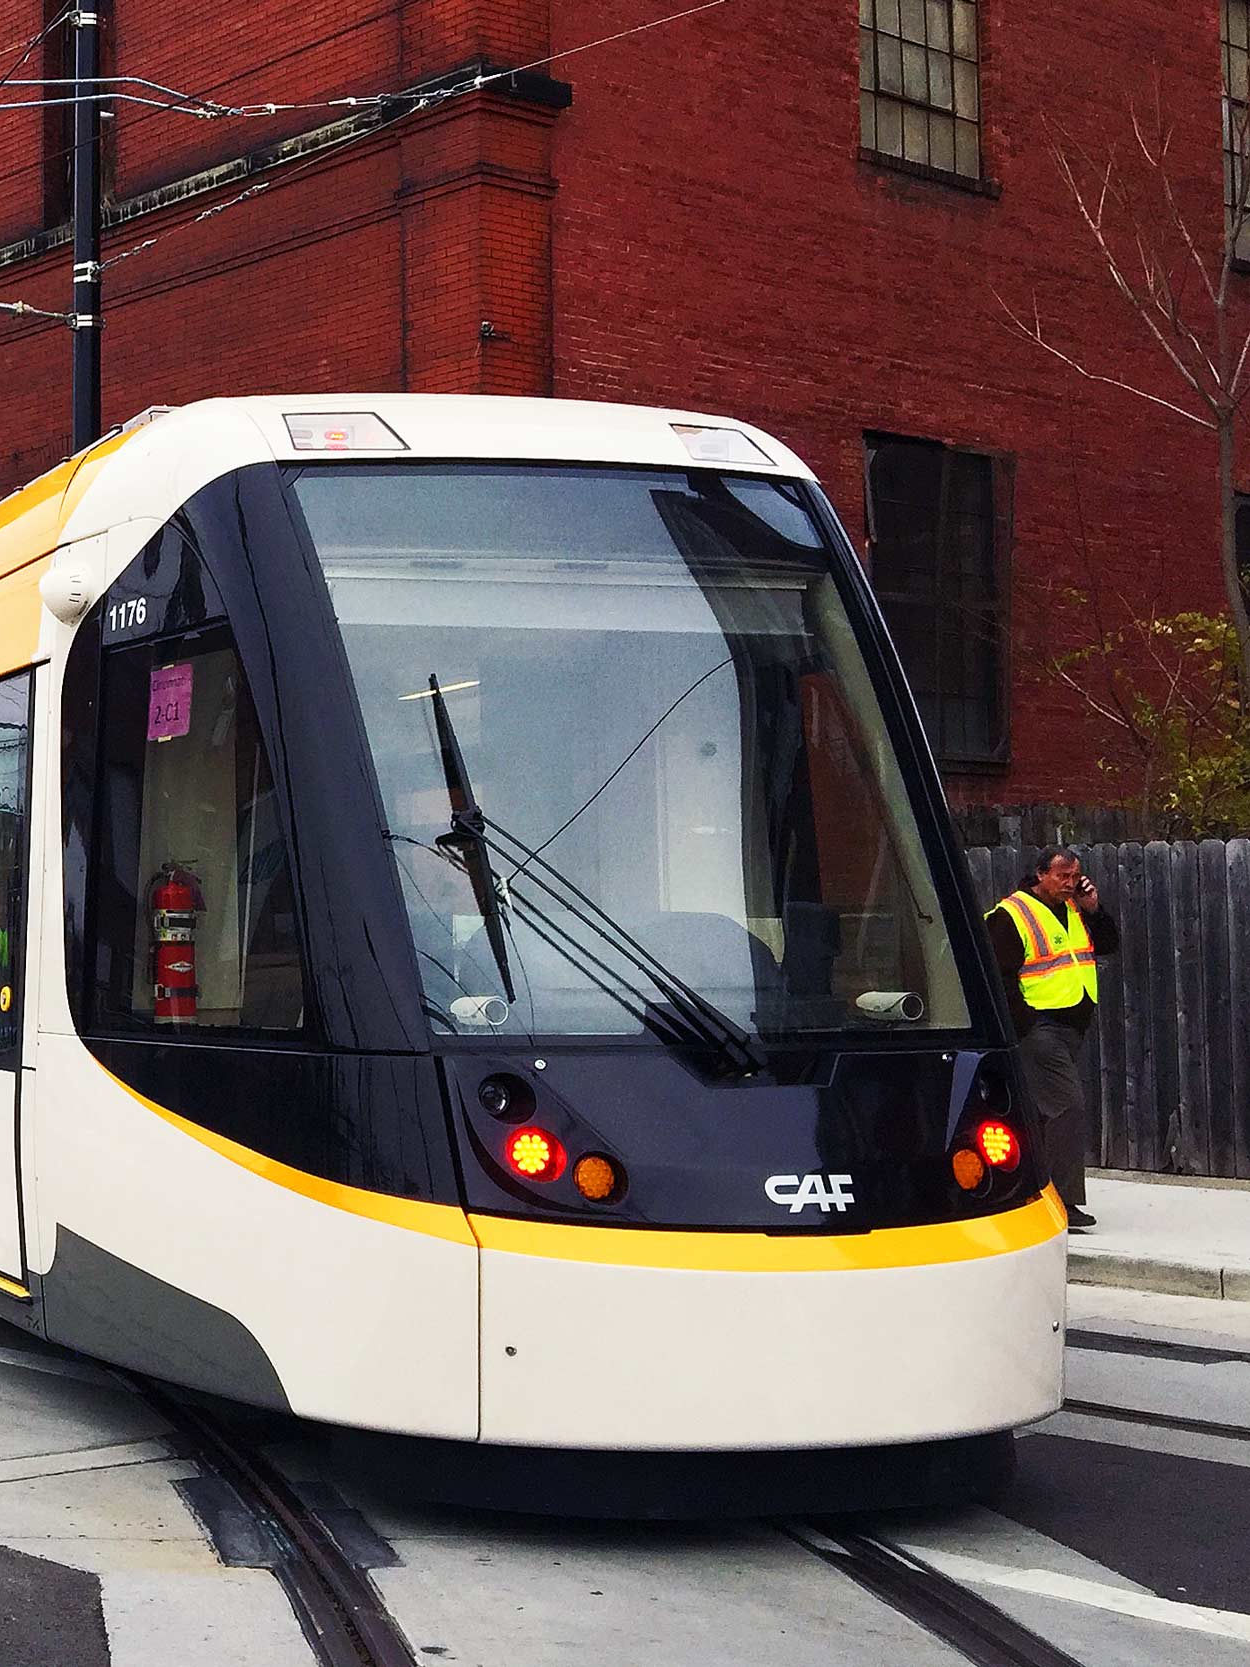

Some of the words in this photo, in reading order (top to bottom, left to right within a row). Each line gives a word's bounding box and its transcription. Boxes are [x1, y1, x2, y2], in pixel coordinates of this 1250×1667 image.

[109, 597, 147, 631] 1176
[154, 702, 179, 724] 2-C1
[764, 1174, 855, 1213] CAF
